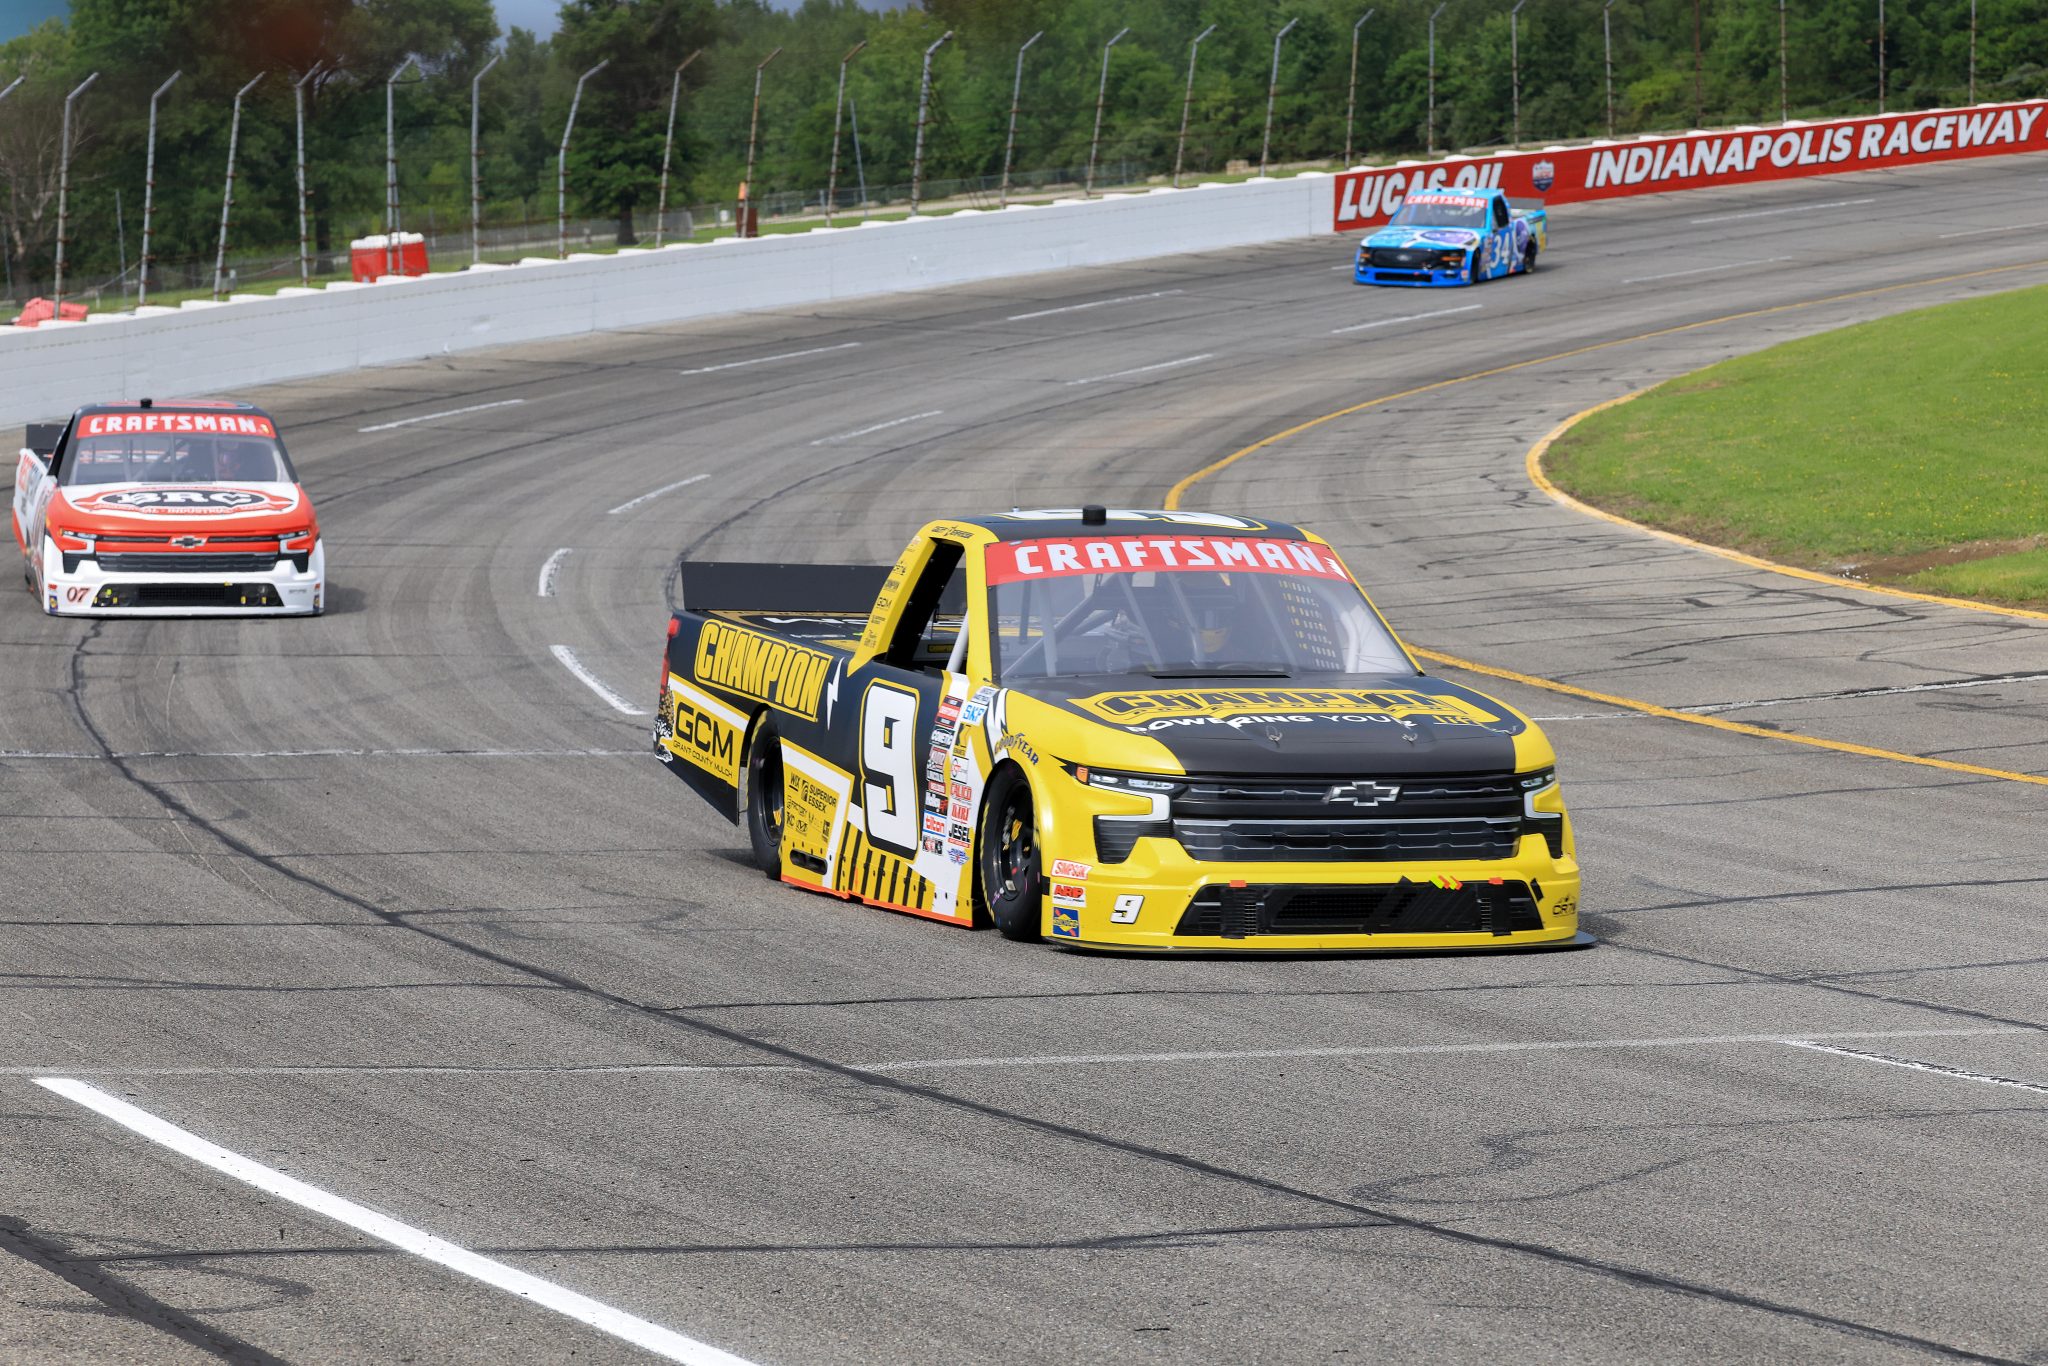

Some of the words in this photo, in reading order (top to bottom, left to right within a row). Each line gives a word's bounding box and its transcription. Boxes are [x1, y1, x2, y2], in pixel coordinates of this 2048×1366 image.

[1584, 126, 1854, 189] INDIANAPOLIS
[1858, 106, 2044, 160] RACEWAY
[1337, 167, 1448, 222] LUCAS
[1407, 195, 1486, 209] CRAFTSMAN
[1490, 232, 1509, 270] 34
[89, 415, 257, 434] CRAFTSMAN
[1015, 540, 1326, 575] CRAFTSMAN
[66, 587, 89, 604] 07
[697, 622, 829, 716] CHAMPION
[1101, 692, 1446, 713] CHAMPION
[675, 701, 734, 766] GCM
[1318, 715, 1418, 728] YOUR
[673, 740, 691, 754] GRANT
[691, 750, 713, 767] COUNTY
[714, 763, 733, 778] MULCH
[994, 733, 1040, 766] GOODYEAR
[864, 683, 920, 851] 9
[808, 795, 827, 813] ESSEX
[809, 784, 837, 807] SUPERIOR
[1054, 884, 1084, 899] ARP
[1110, 893, 1145, 925] 9
